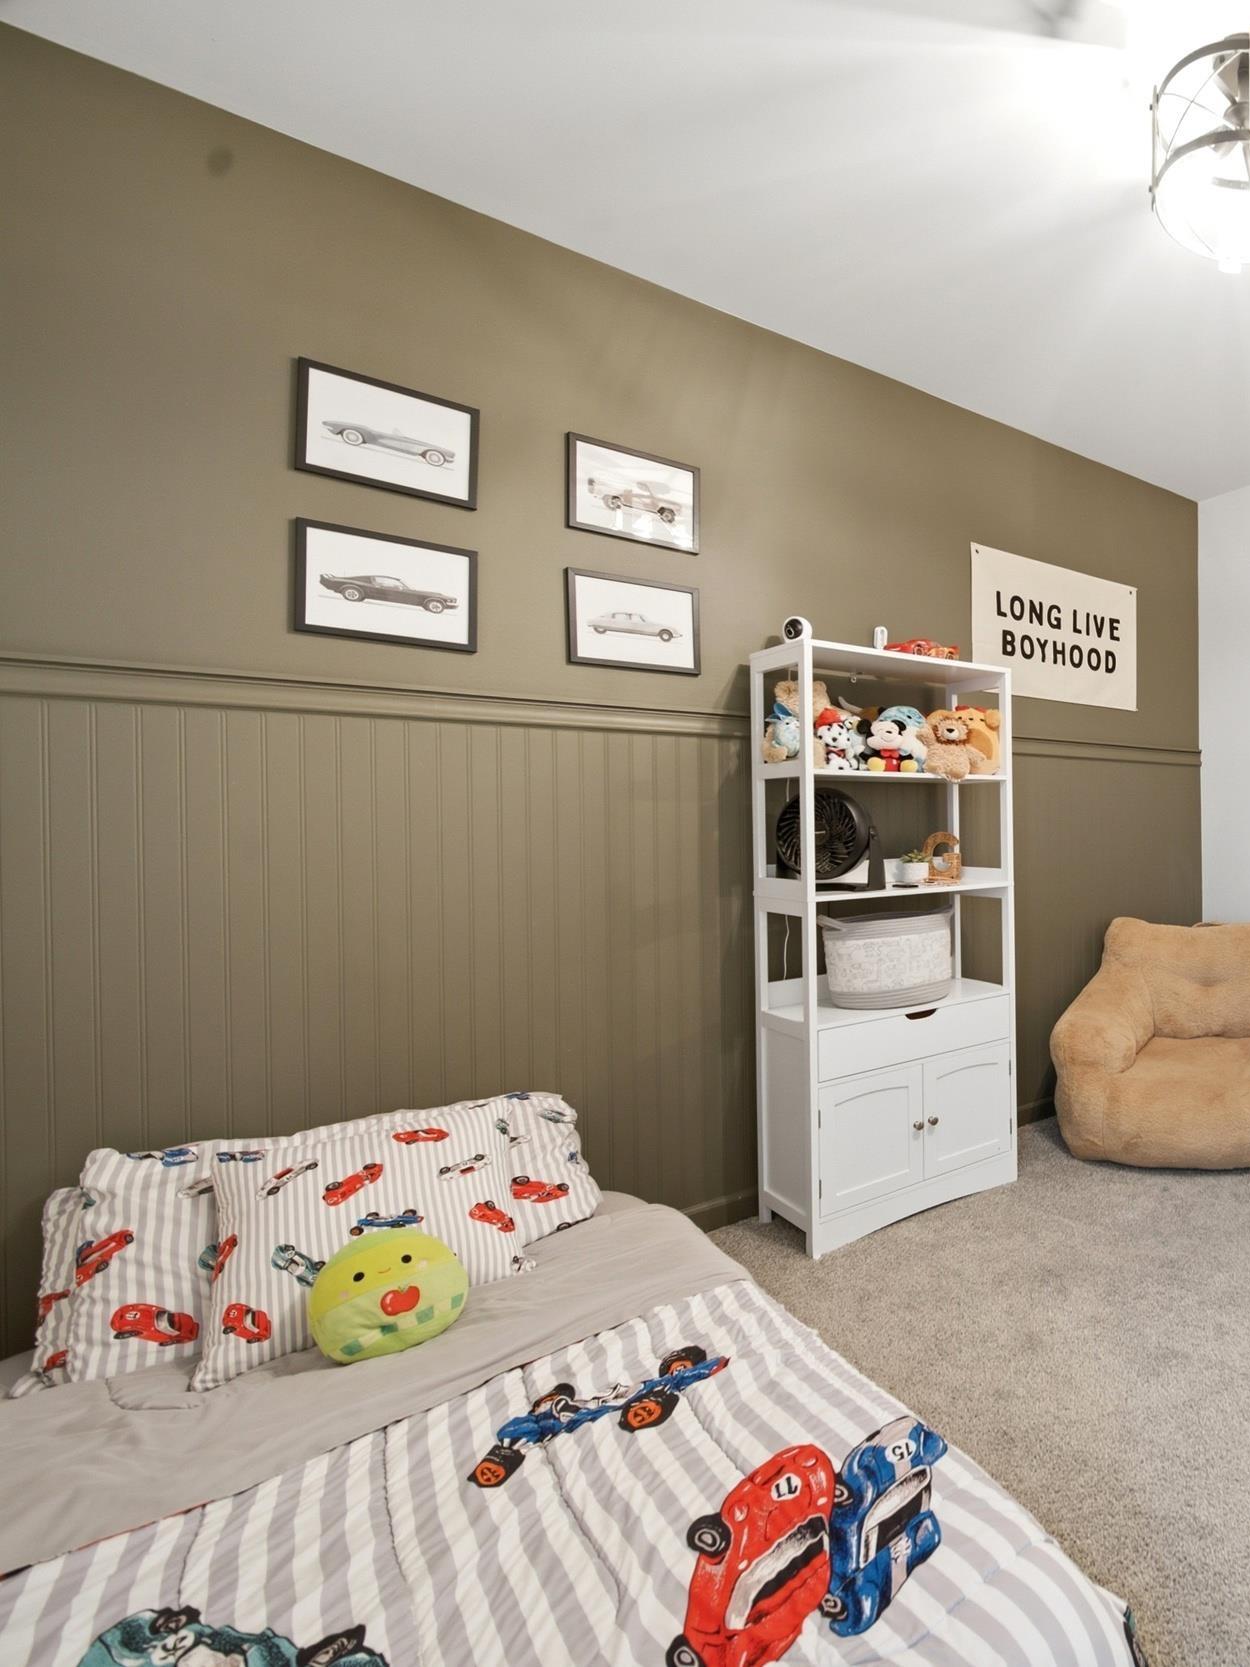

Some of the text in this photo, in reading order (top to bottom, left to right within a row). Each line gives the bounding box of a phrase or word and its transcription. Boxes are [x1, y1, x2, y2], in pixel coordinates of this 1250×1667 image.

[995, 590, 1121, 642] LONG LIVE
[1001, 629, 1117, 674] BOYHOOD
[891, 1441, 914, 1462] 15
